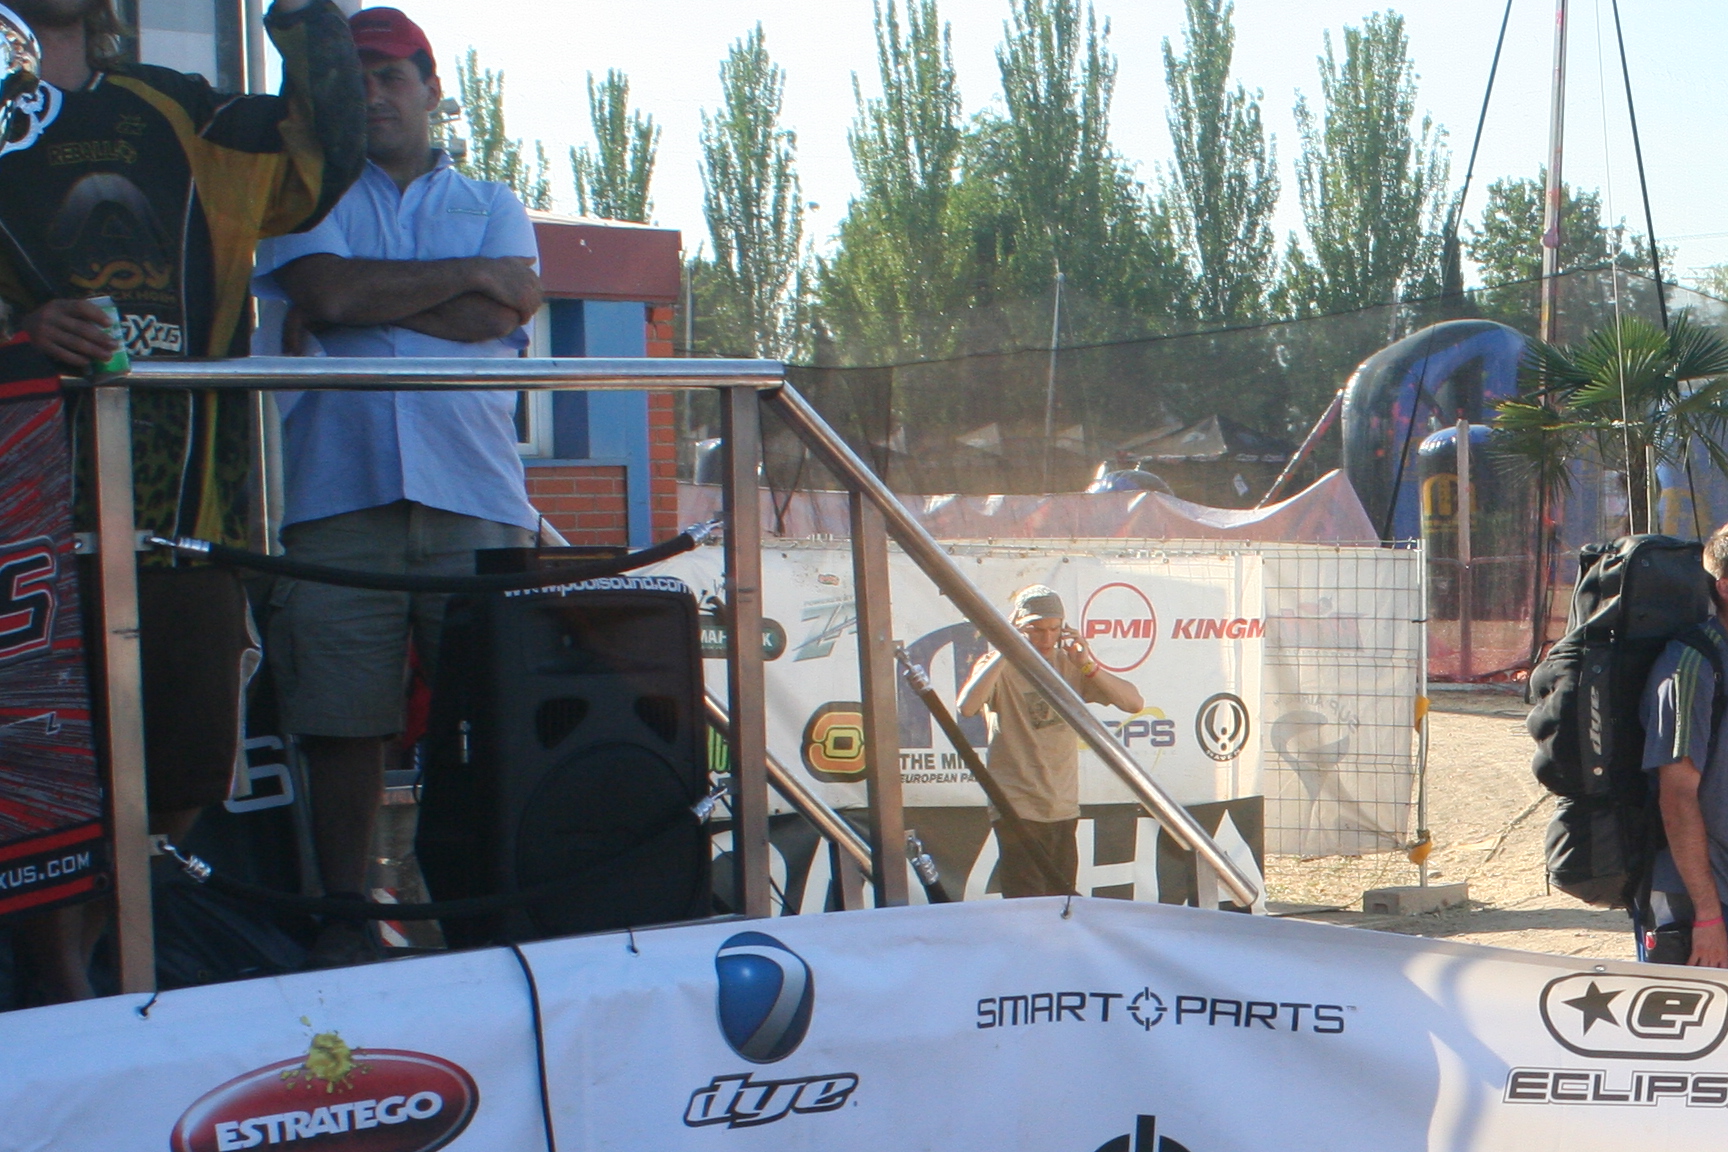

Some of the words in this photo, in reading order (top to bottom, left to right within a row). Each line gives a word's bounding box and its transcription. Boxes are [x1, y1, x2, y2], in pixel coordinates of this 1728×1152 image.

[1085, 618, 1152, 639] PMI
[900, 753, 937, 770] THE
[976, 991, 1124, 1030] SMART
[1174, 995, 1346, 1034] PARTS
[216, 1090, 443, 1152] ESTRATEGO
[683, 1072, 858, 1129] dye
